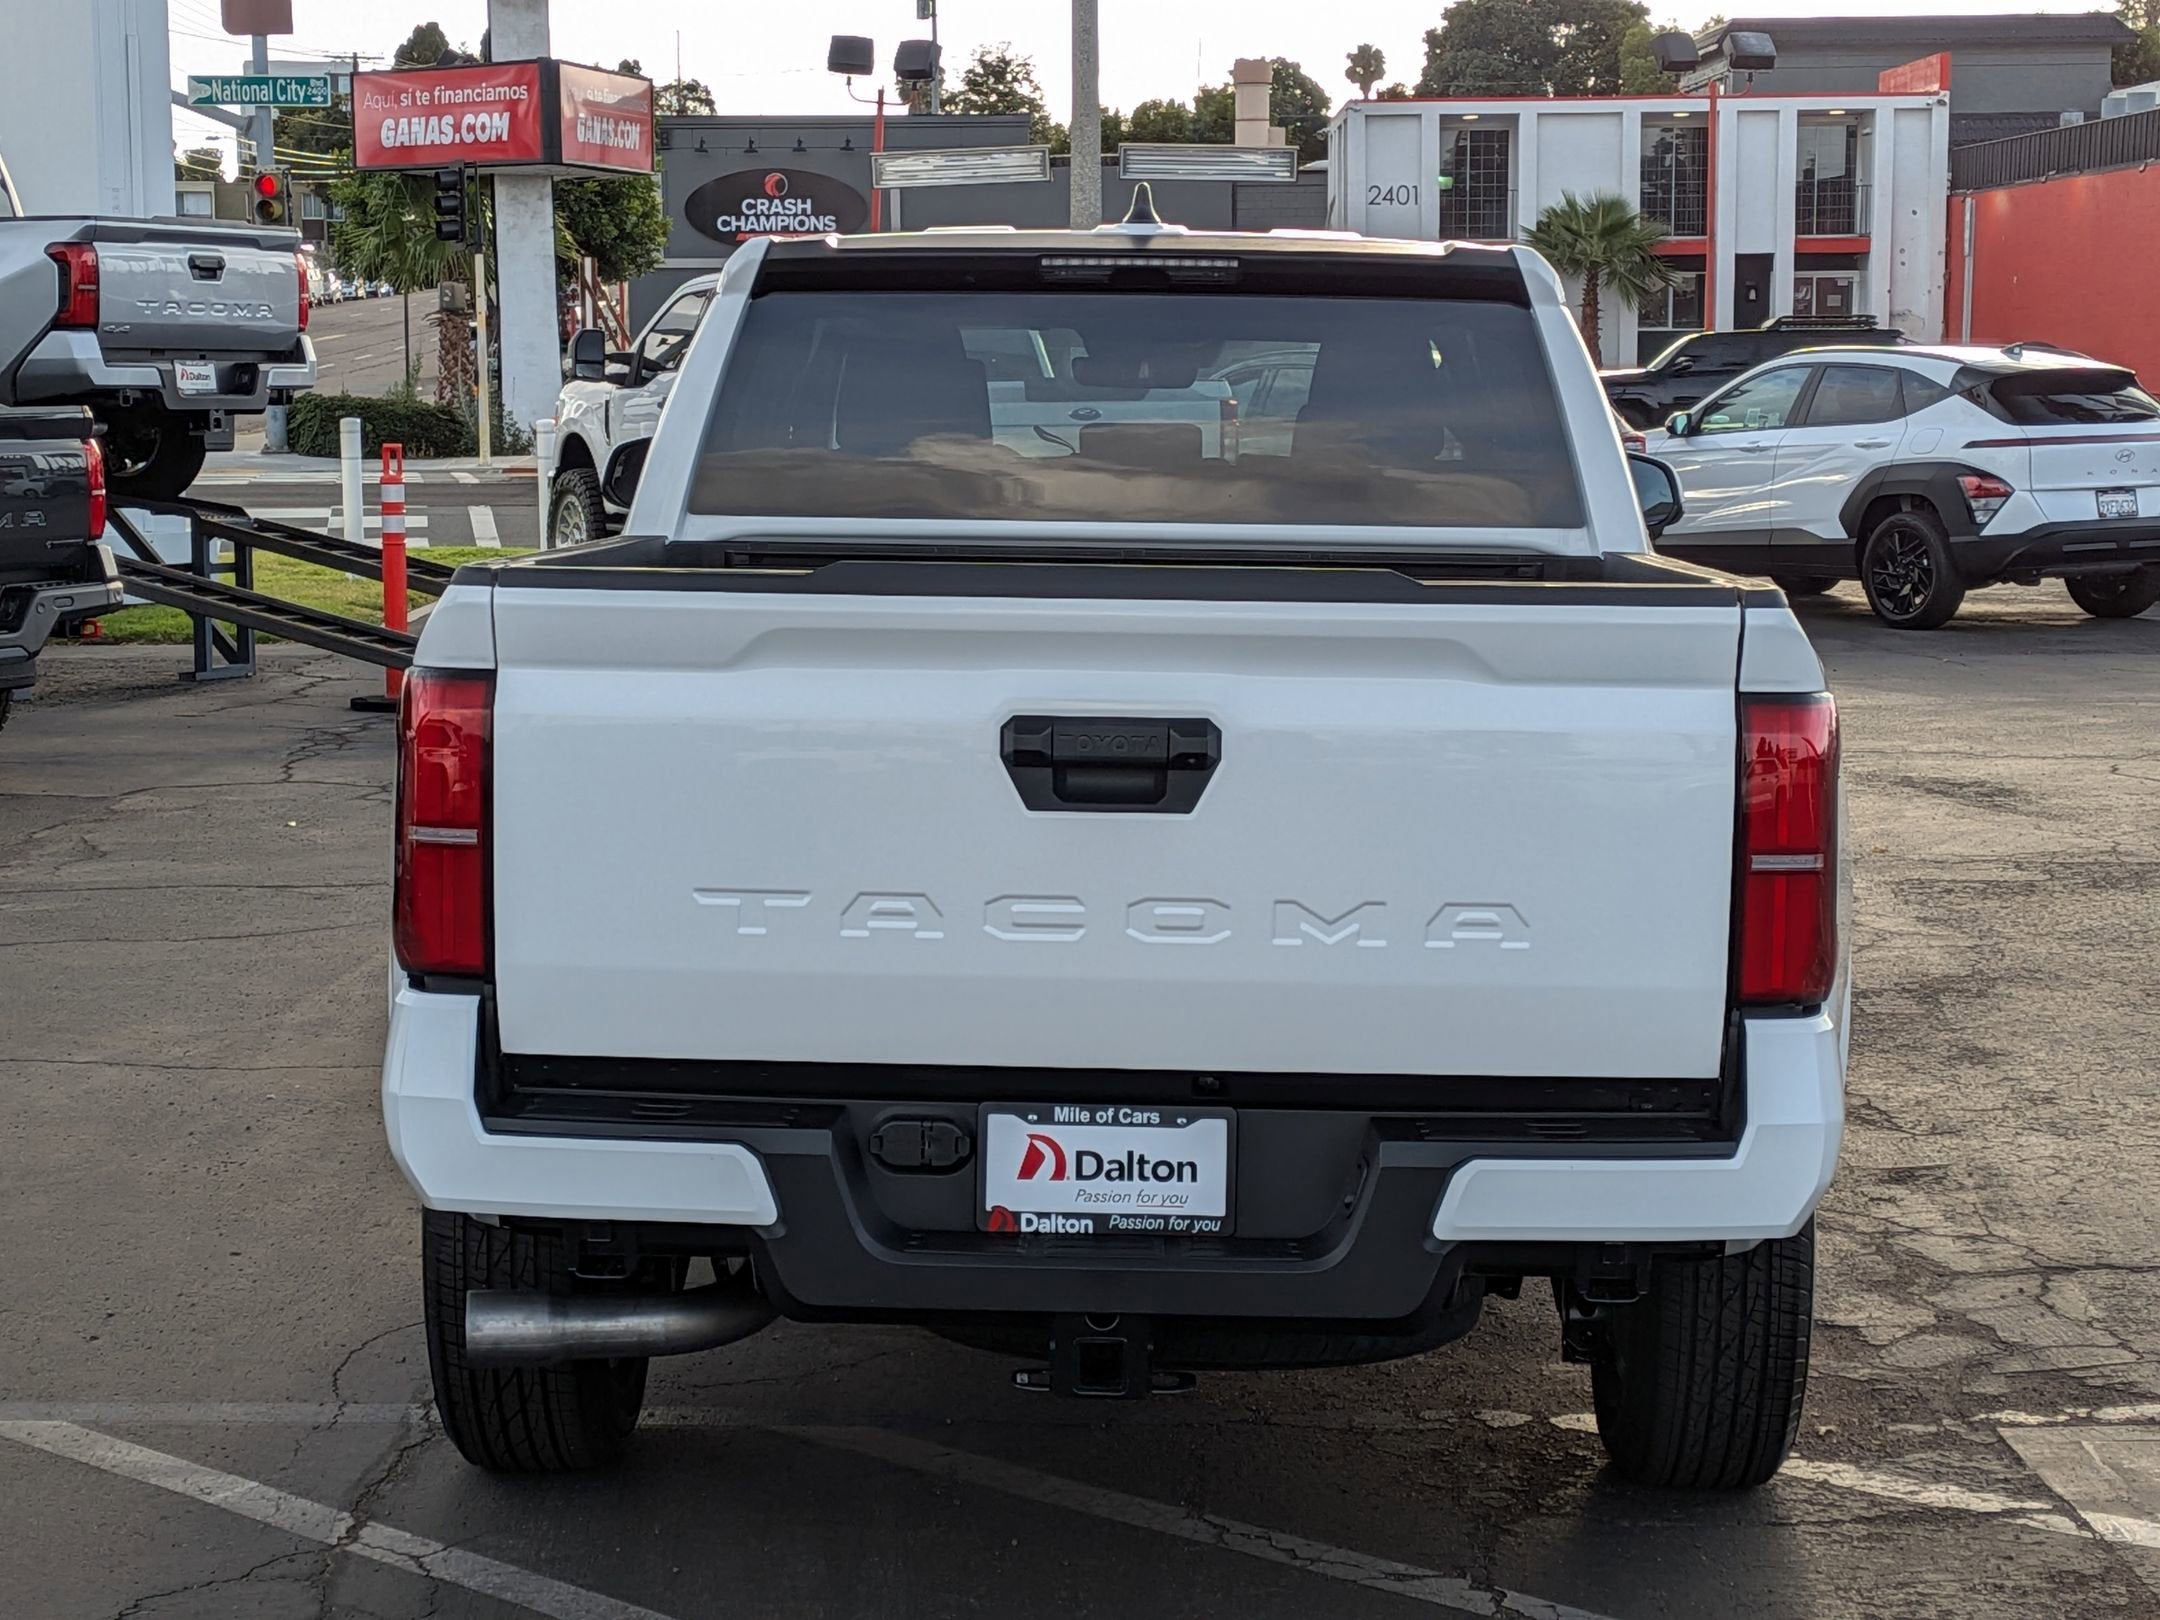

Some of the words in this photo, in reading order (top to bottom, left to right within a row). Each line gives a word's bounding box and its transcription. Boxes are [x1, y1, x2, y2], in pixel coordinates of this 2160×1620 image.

[212, 80, 273, 102] National
[277, 80, 306, 103] City
[363, 91, 398, 111] Aquí,
[400, 88, 412, 107] sí
[416, 90, 430, 105] te
[434, 83, 528, 104] financiamos
[381, 112, 510, 148] GANAS.COM
[577, 113, 640, 150] GANAS.COM
[1368, 185, 1418, 206] 2401
[741, 198, 811, 215] CRASH
[717, 215, 837, 232] CHAMPIONS
[136, 300, 273, 318] TACOMA
[2087, 467, 2158, 476] KONA
[1059, 734, 1162, 751] TOYOTA
[693, 888, 1531, 950] TACOMA
[1054, 1106, 1090, 1123] Mile
[1096, 1108, 1115, 1123] of
[1119, 1109, 1160, 1125] Cars
[1075, 1150, 1198, 1183] Dalton
[1075, 1189, 1131, 1204] Passion
[1136, 1189, 1160, 1204] for
[1162, 1193, 1189, 1206] you
[1020, 1213, 1093, 1234] Dalton
[1109, 1215, 1164, 1231] Passion
[1168, 1216, 1190, 1232] for
[1192, 1219, 1222, 1233] you
